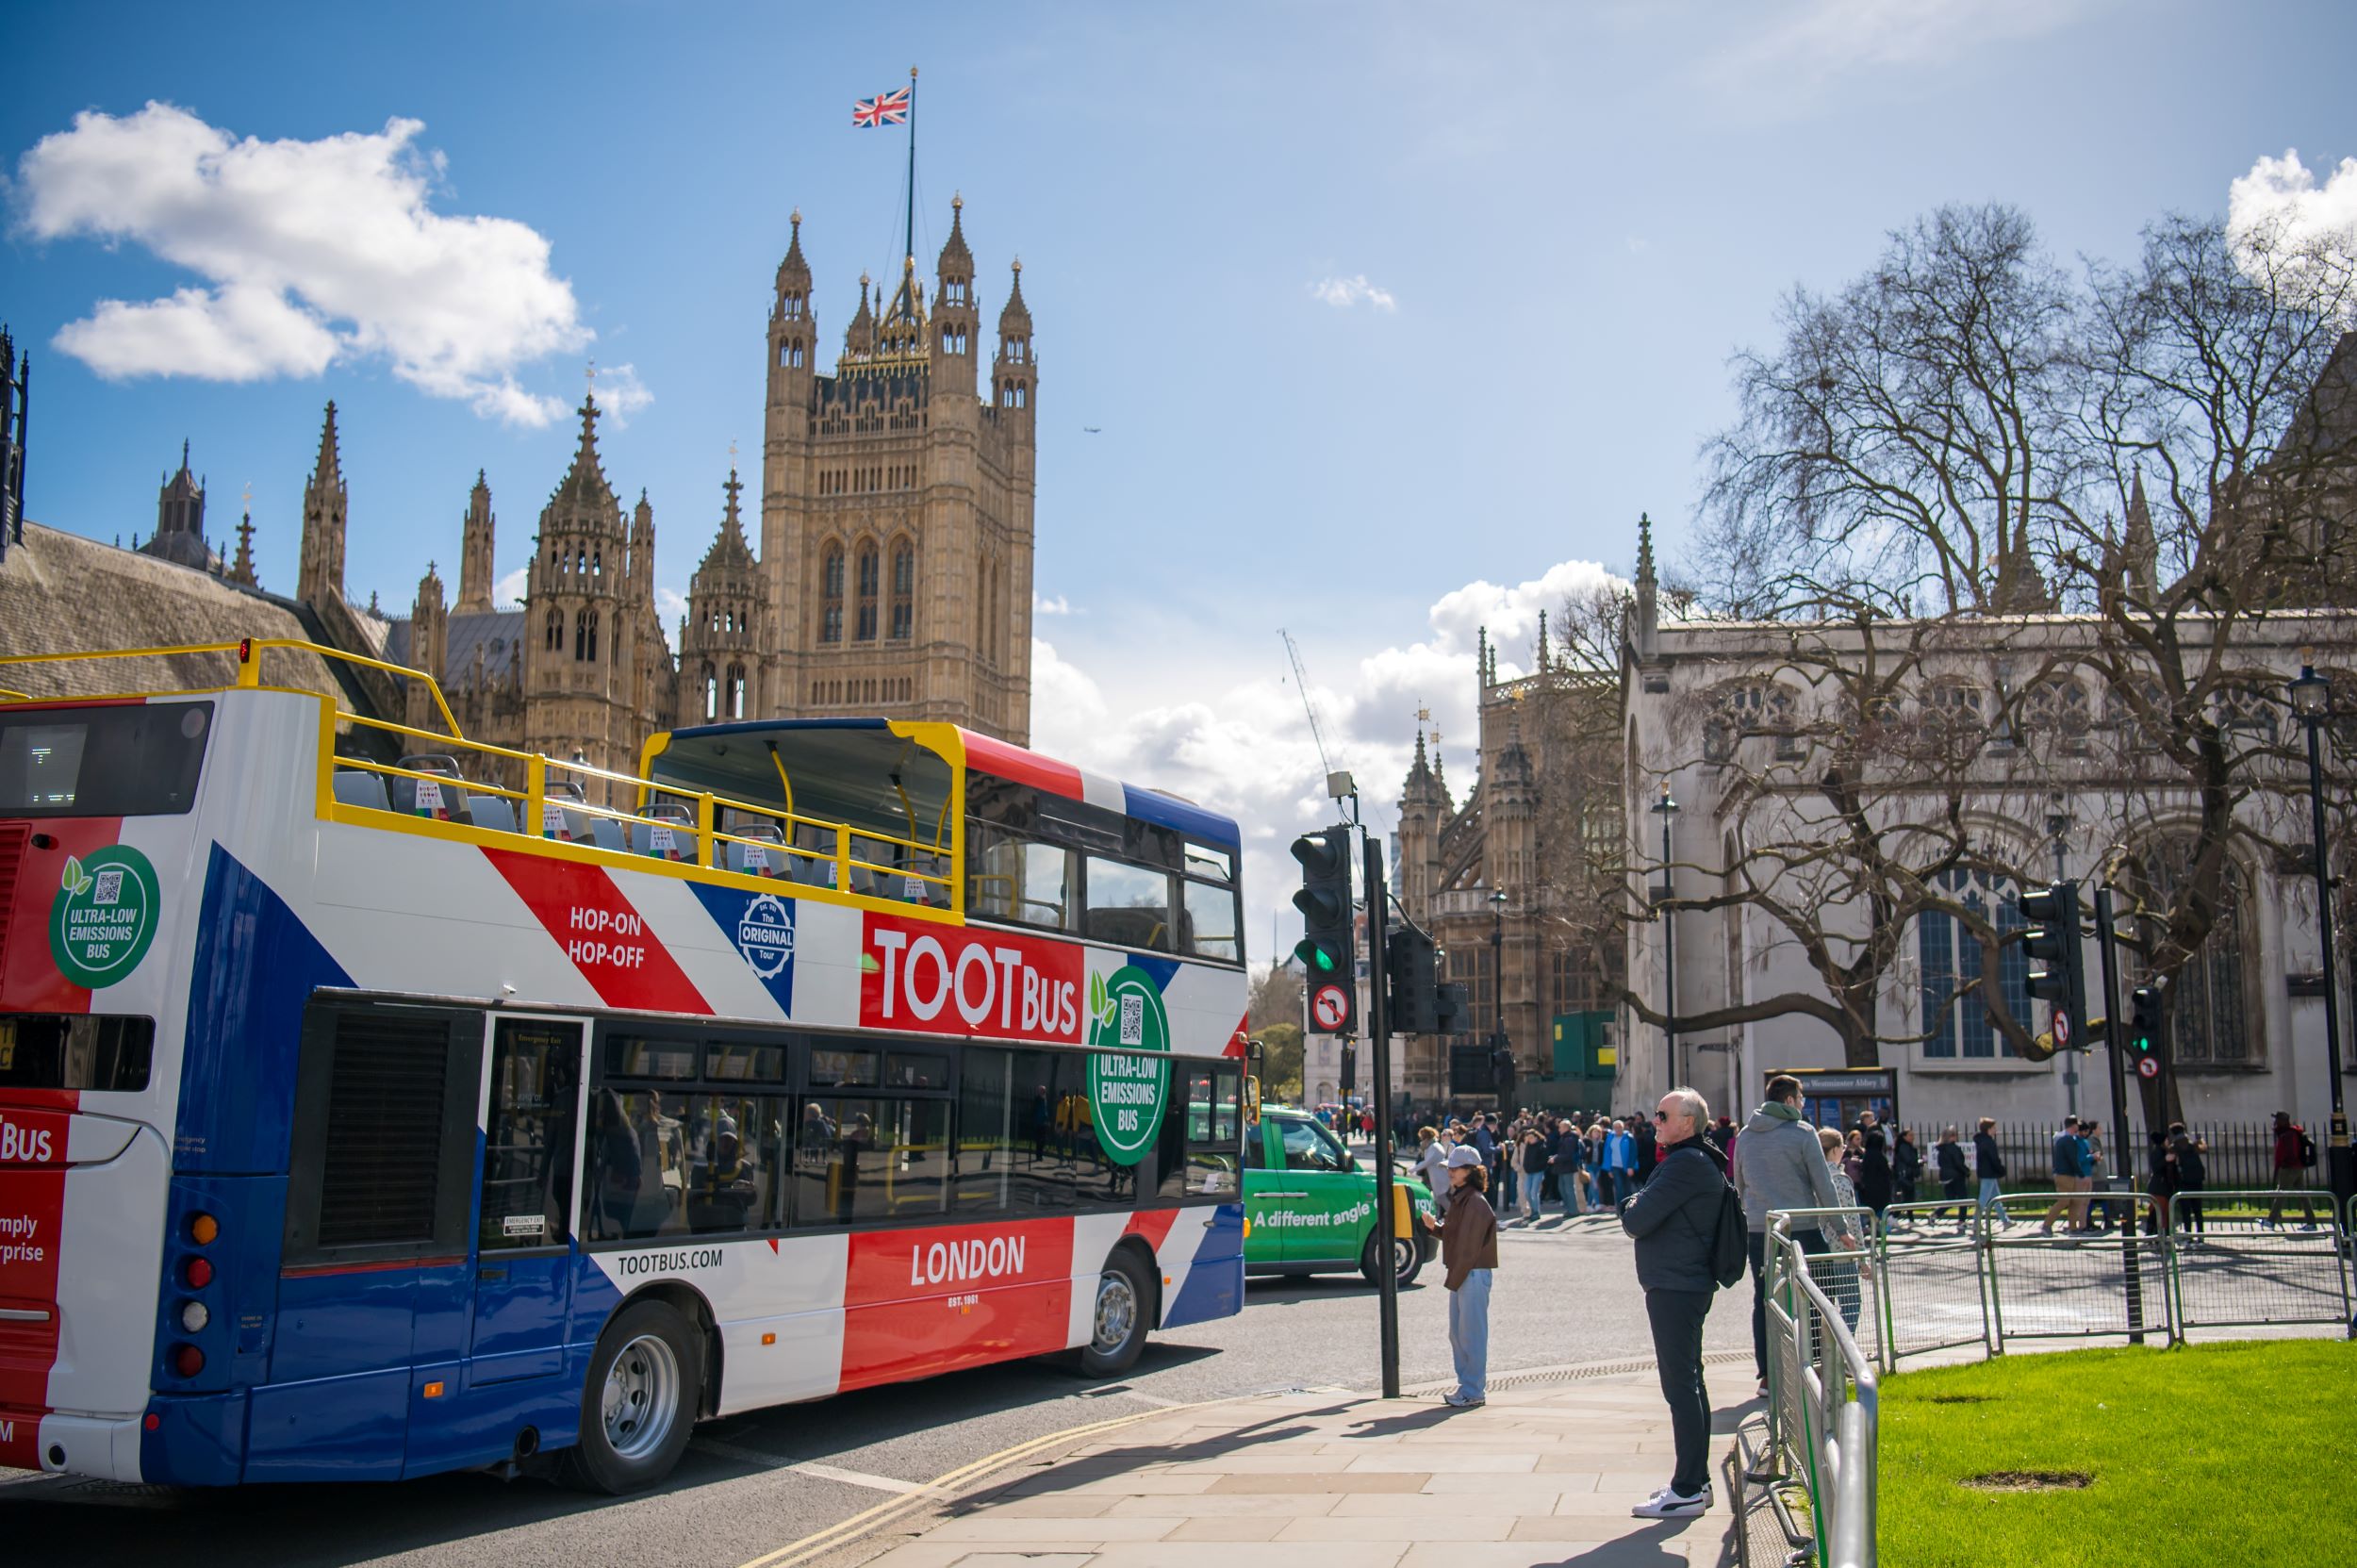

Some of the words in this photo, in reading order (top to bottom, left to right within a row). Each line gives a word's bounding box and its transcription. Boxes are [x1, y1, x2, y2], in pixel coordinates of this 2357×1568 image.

[71, 908, 137, 923] ULTRA-LOW
[570, 906, 641, 936] HOP-ON
[762, 913, 774, 923] The
[69, 926, 132, 941] EMISSIONS
[742, 926, 793, 946] ORIGINAL
[86, 944, 110, 958] BUS
[569, 939, 645, 968] HOP-OFF
[759, 949, 775, 960] Tour
[518, 1033, 549, 1044] Emergency
[1100, 1054, 1158, 1079] ULTRA-LOW
[1100, 1081, 1156, 1105] EMISSIONS
[1810, 1079, 1854, 1087] Westminster
[1854, 1078, 1877, 1089] Abbey
[1117, 1109, 1138, 1131] BUS
[0, 1114, 53, 1163] BUS
[1253, 1212, 1266, 1227] A
[1267, 1211, 1329, 1227] different
[1333, 1201, 1370, 1226] angle
[618, 1249, 723, 1276] TOOTBUS.COM
[910, 1235, 1026, 1287] LONDON
[948, 1296, 964, 1308] EST.
